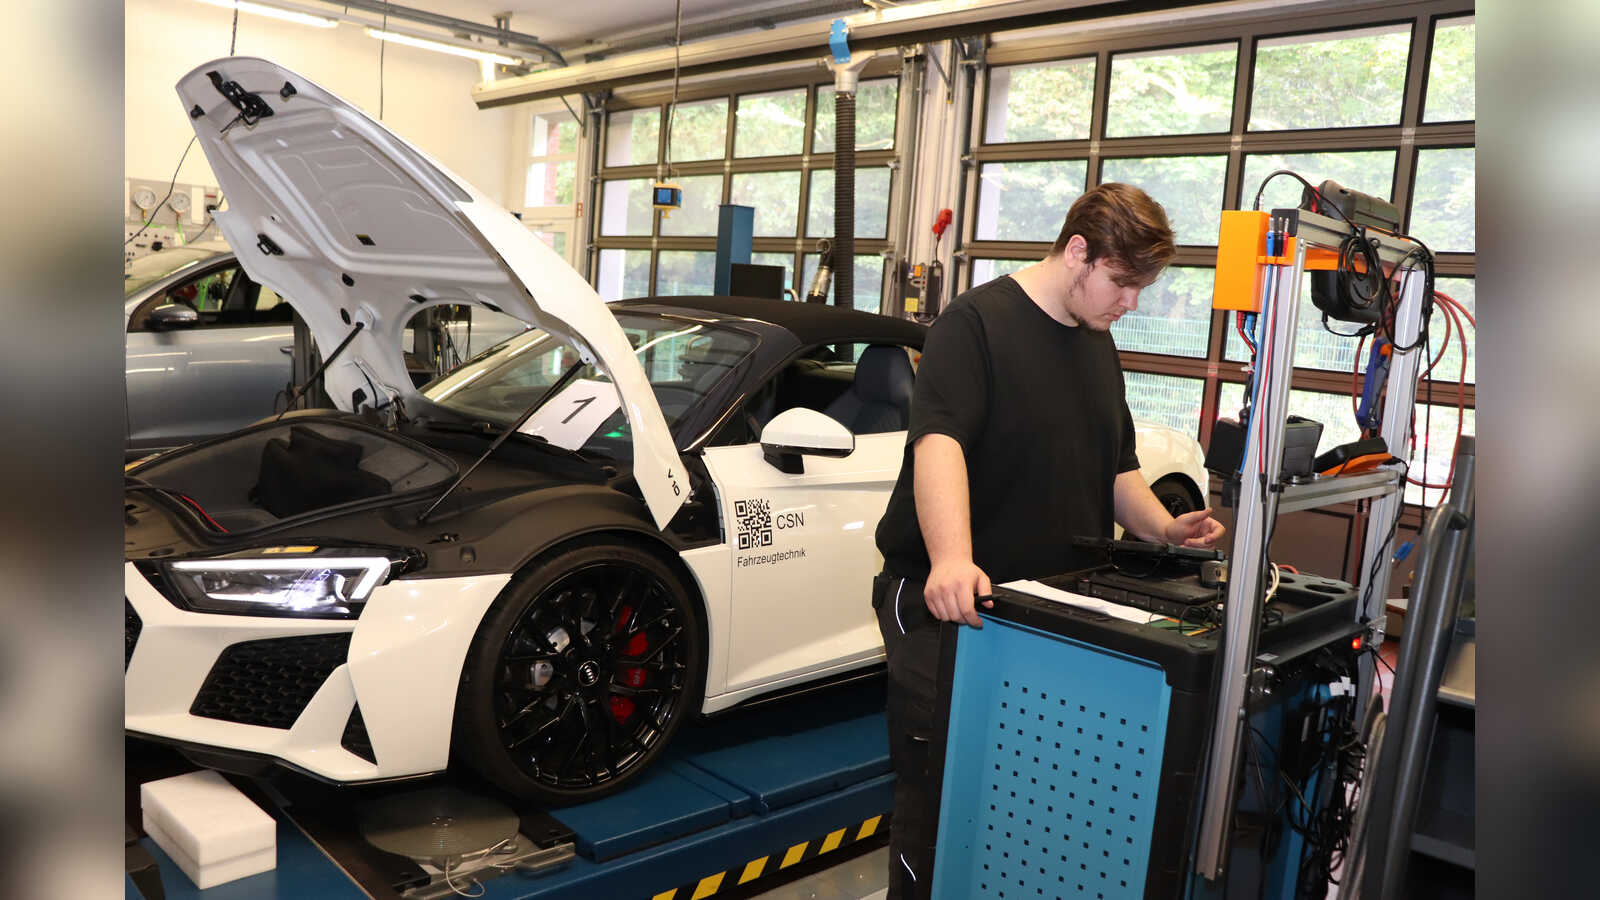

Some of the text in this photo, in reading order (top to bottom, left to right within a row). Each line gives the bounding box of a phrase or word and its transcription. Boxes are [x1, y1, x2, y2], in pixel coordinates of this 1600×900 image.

[560, 396, 597, 425] 1
[776, 512, 804, 530] CSN
[737, 547, 806, 568] Fahrzeugtechnik
